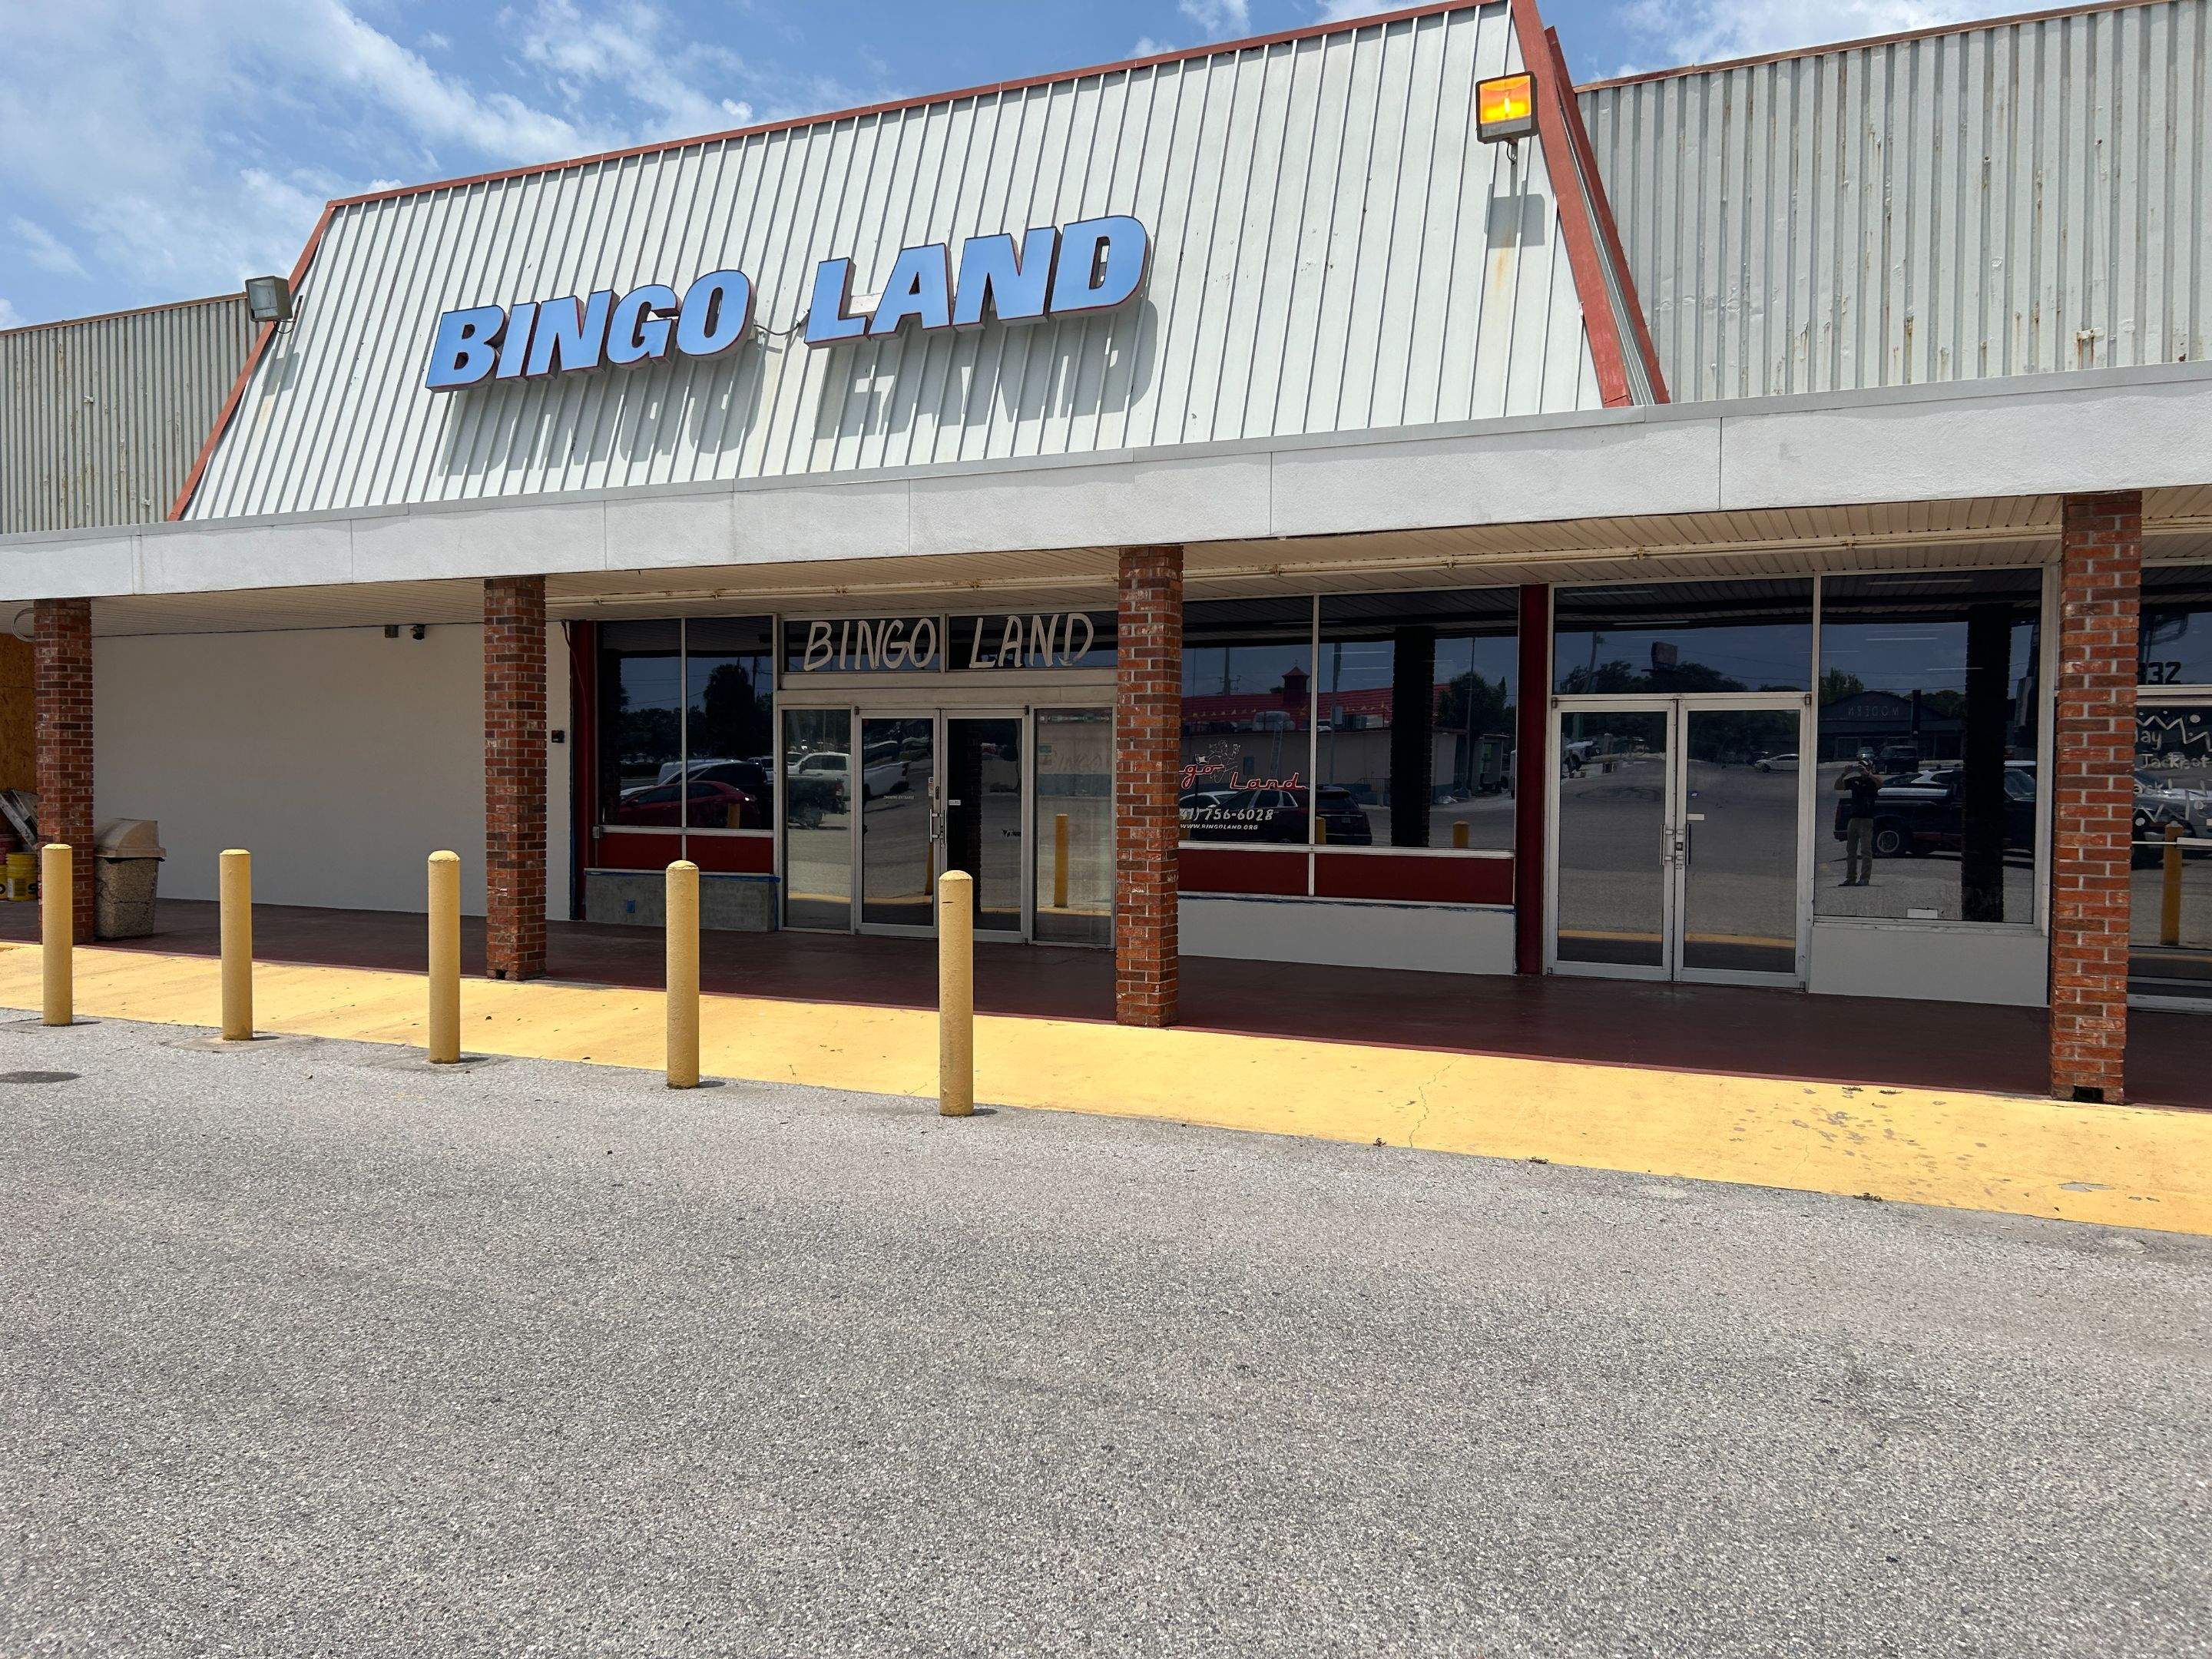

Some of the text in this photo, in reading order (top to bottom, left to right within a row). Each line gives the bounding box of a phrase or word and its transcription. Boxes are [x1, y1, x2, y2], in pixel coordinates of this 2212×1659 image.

[426, 215, 1152, 392] BINGO LAND
[803, 613, 1094, 671] BINGO LAND
[1230, 771, 1310, 790] Land
[1204, 808, 1274, 821] 756-6028
